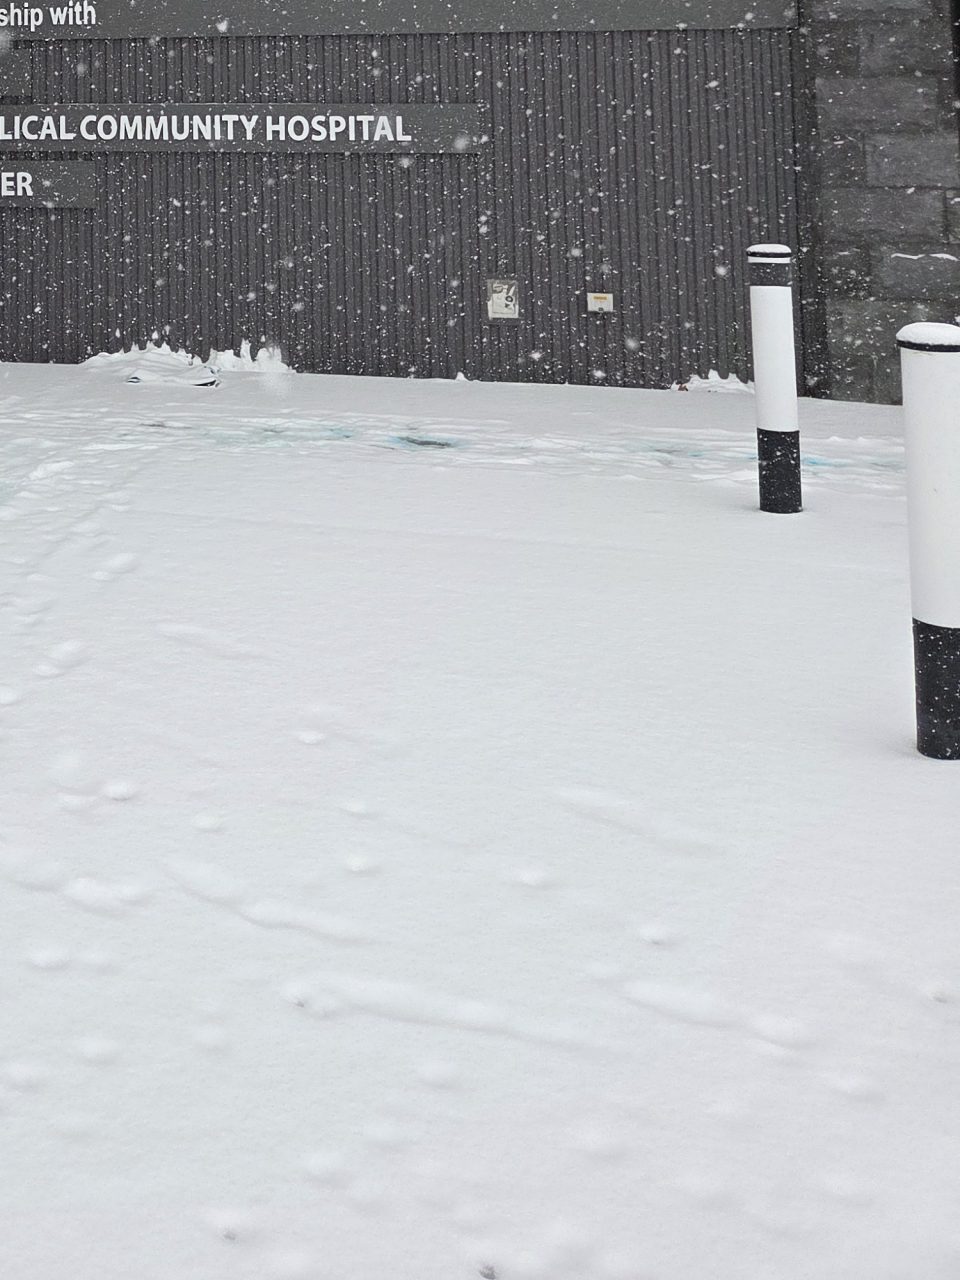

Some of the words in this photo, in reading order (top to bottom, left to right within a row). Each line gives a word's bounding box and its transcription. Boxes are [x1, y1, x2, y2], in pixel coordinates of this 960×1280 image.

[49, 0, 96, 25] with
[79, 115, 259, 140] COMMUNITY
[266, 115, 412, 141] HOSPITAL
